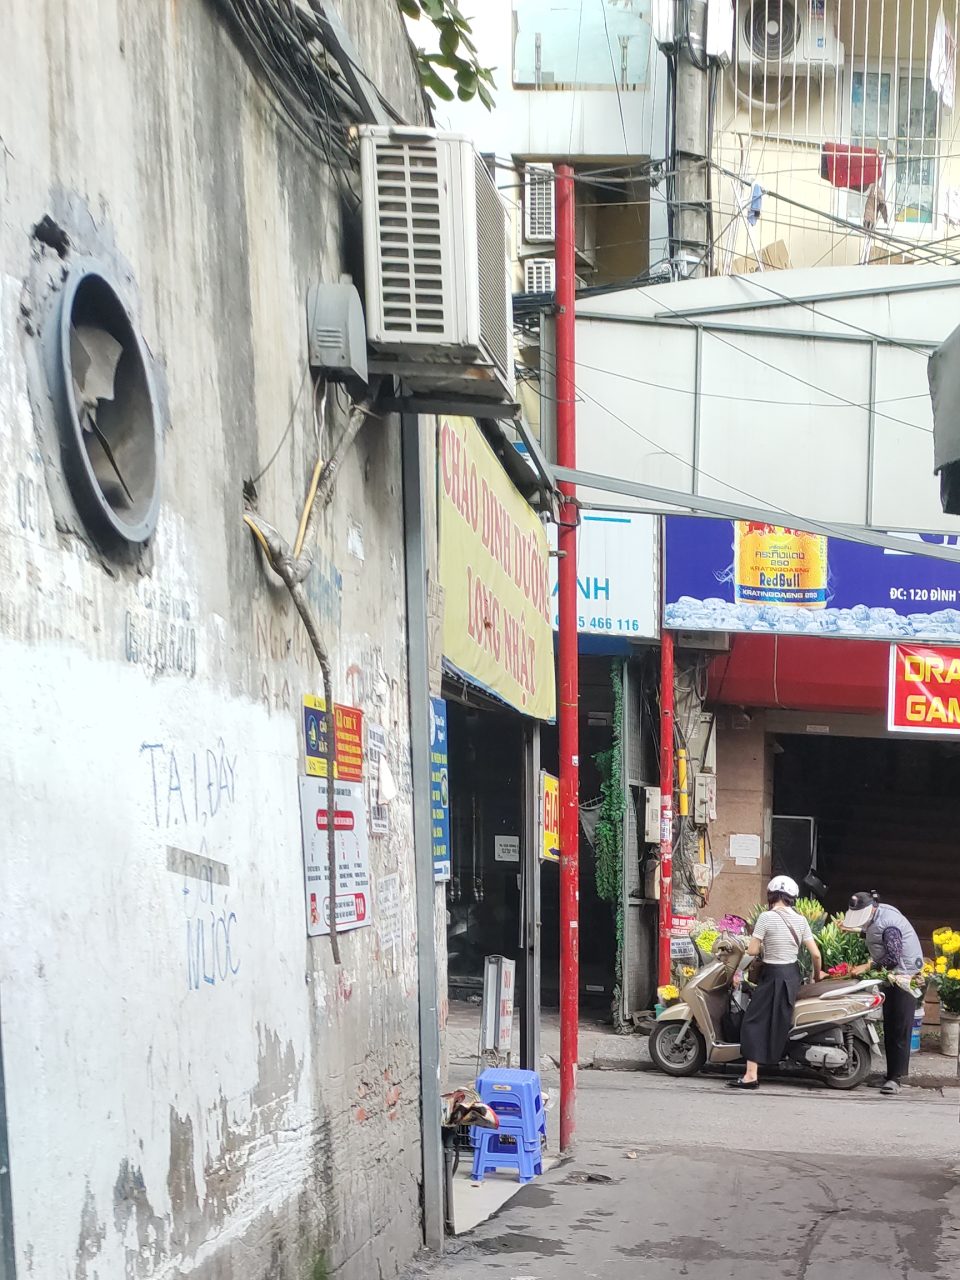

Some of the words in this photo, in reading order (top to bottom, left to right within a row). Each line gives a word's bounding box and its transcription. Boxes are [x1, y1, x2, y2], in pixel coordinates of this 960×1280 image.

[441, 420, 478, 533] CHÁO
[481, 477, 513, 579] DINH
[590, 616, 612, 630] 466
[617, 618, 639, 631] 116
[909, 588, 928, 601] 120
[930, 586, 956, 602] ĐÌNH
[466, 564, 500, 664] LONG
[503, 609, 536, 706] NHẬT
